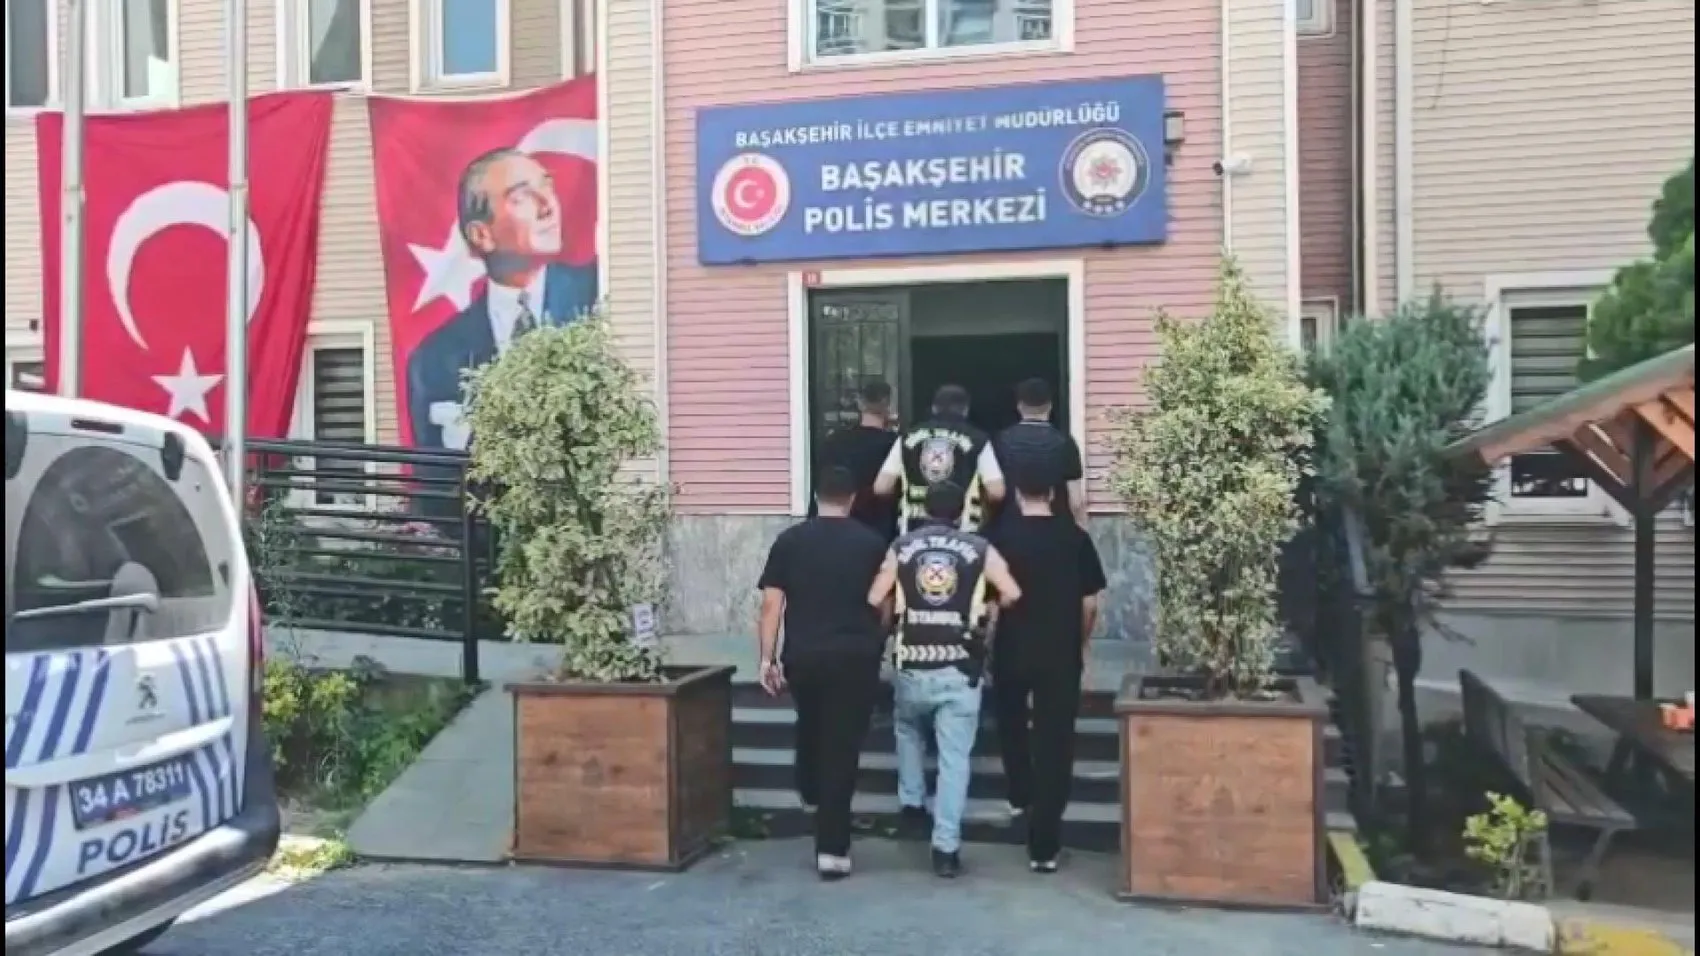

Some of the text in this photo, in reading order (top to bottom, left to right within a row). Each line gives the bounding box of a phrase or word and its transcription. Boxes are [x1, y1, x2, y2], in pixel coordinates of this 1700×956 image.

[735, 120, 852, 148] BAŞAKŞEHİR
[857, 118, 899, 141] İLÇE
[821, 147, 1025, 191] BAŞAKŞEHİR
[804, 196, 894, 234] POLİS
[903, 187, 1046, 228] MERKEZİ
[79, 761, 184, 813] 34 A 78311
